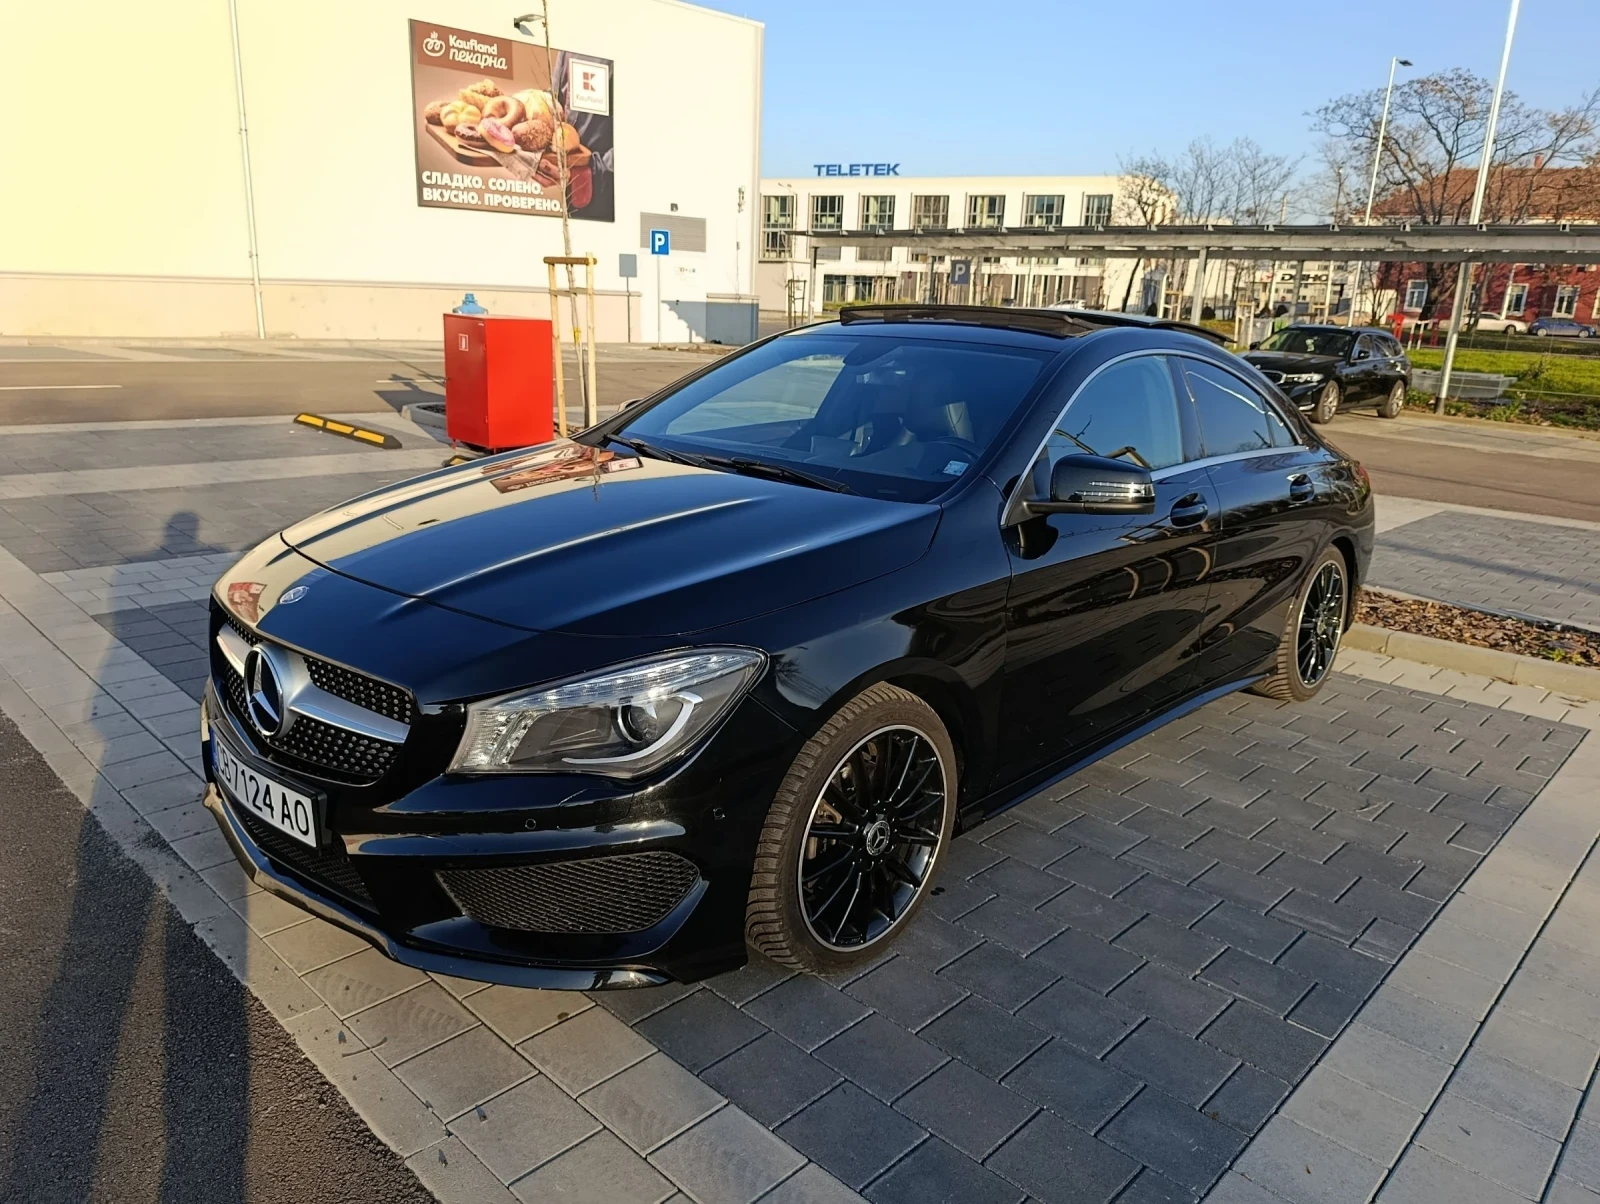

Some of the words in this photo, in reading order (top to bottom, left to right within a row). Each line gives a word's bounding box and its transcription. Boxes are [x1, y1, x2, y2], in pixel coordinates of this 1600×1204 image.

[448, 34, 498, 55] Kaufland
[813, 163, 901, 177] TELETEK
[421, 170, 486, 189] СЛАДКО.
[488, 177, 544, 195] СОЛЕНО.
[422, 187, 481, 205] ВКУСНО.
[484, 193, 563, 212] ПРОВЕРЕНО.
[654, 233, 666, 252] P
[954, 263, 967, 281] P
